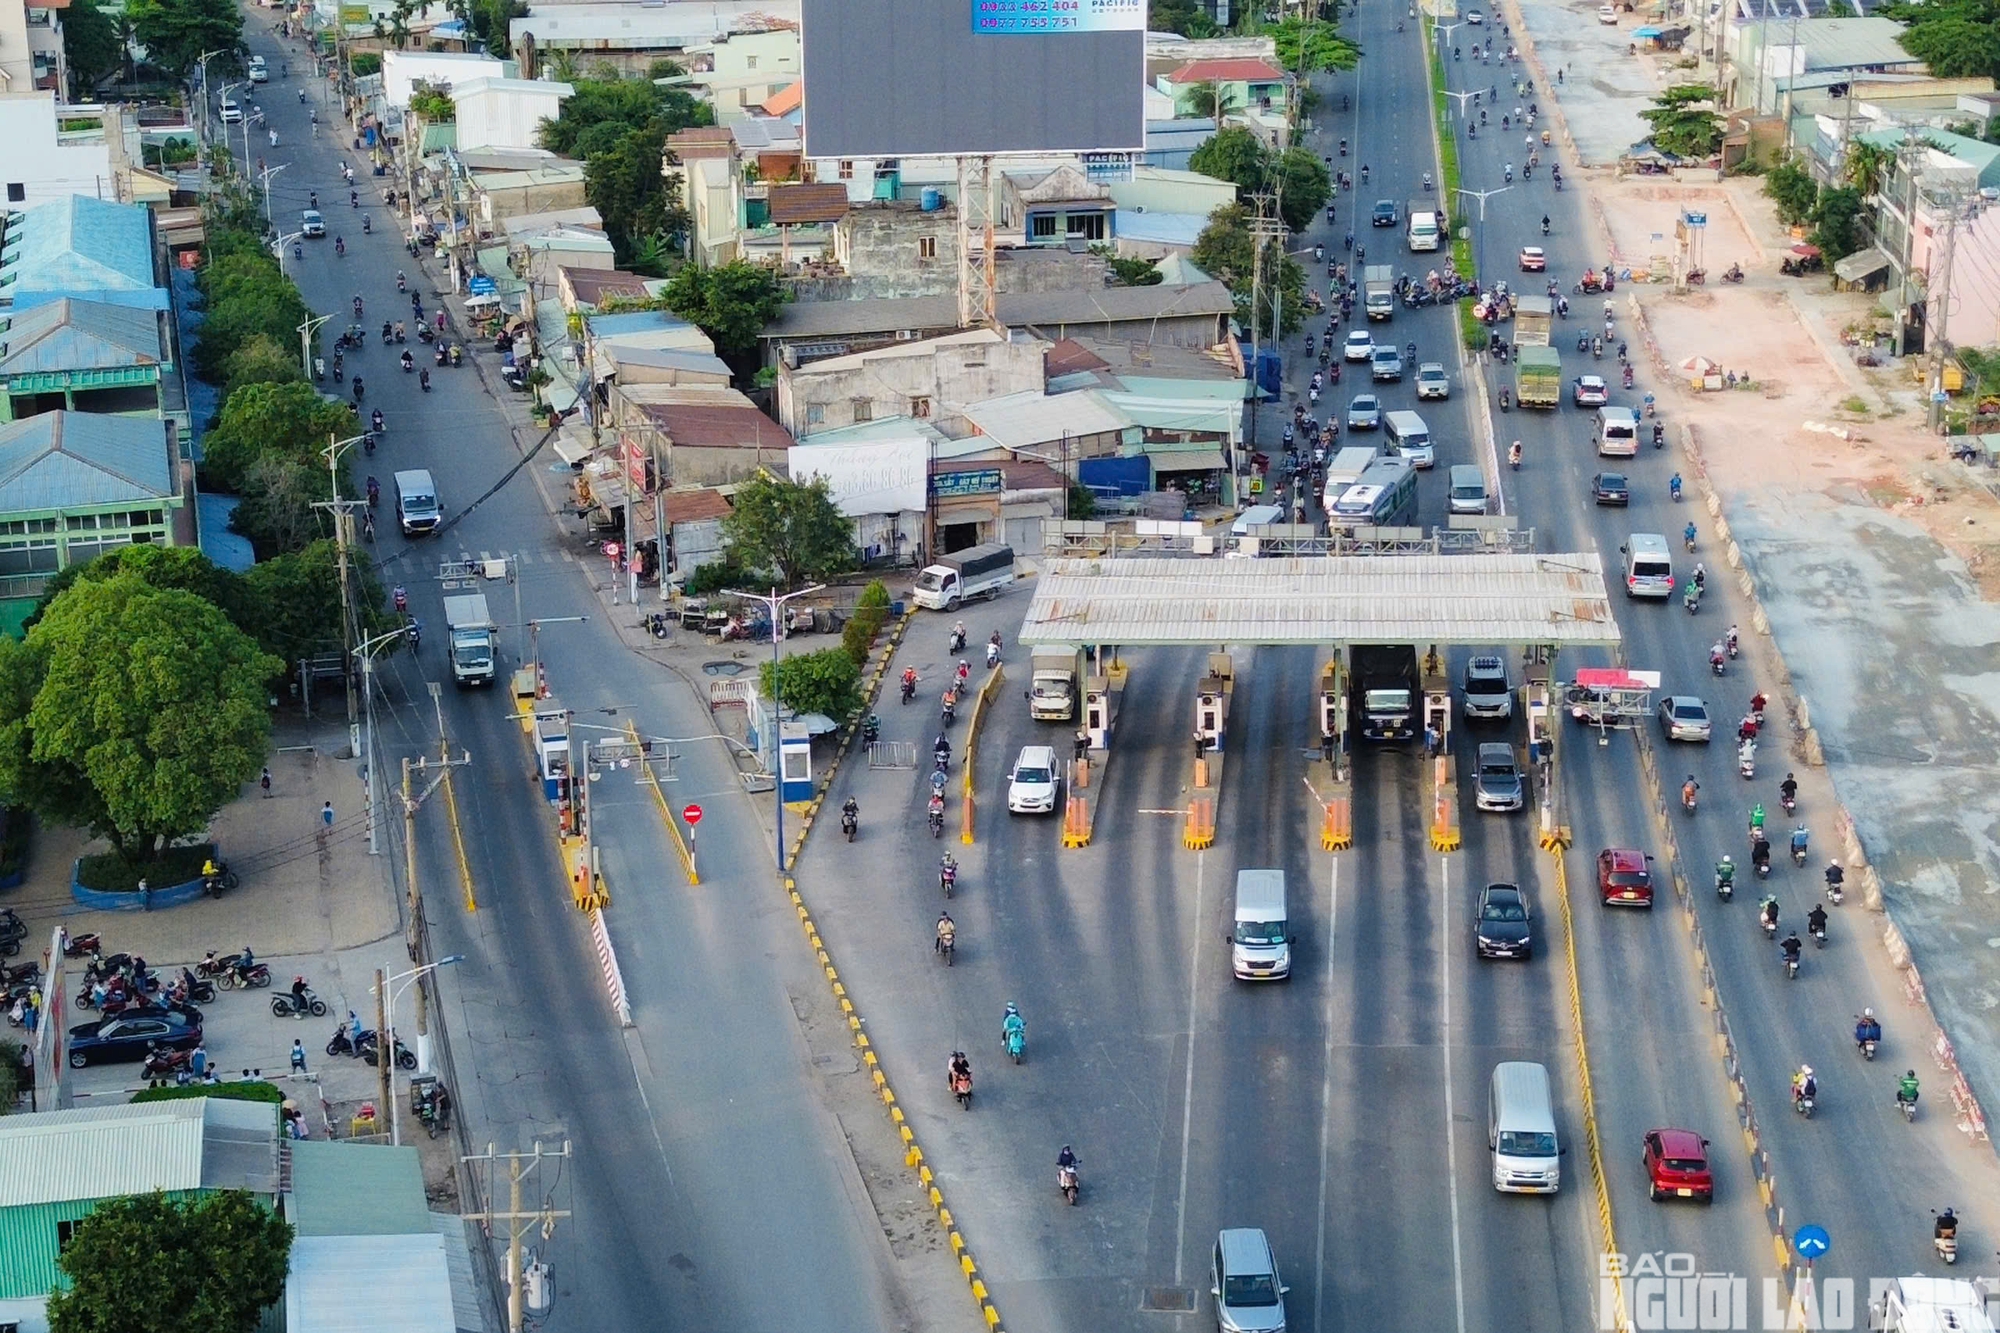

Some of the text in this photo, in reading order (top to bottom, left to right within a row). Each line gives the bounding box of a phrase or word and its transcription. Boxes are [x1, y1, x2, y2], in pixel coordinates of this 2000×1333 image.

[1052, 1, 1079, 11] 404
[980, 18, 1017, 28] 0977
[1052, 17, 1078, 27] 751
